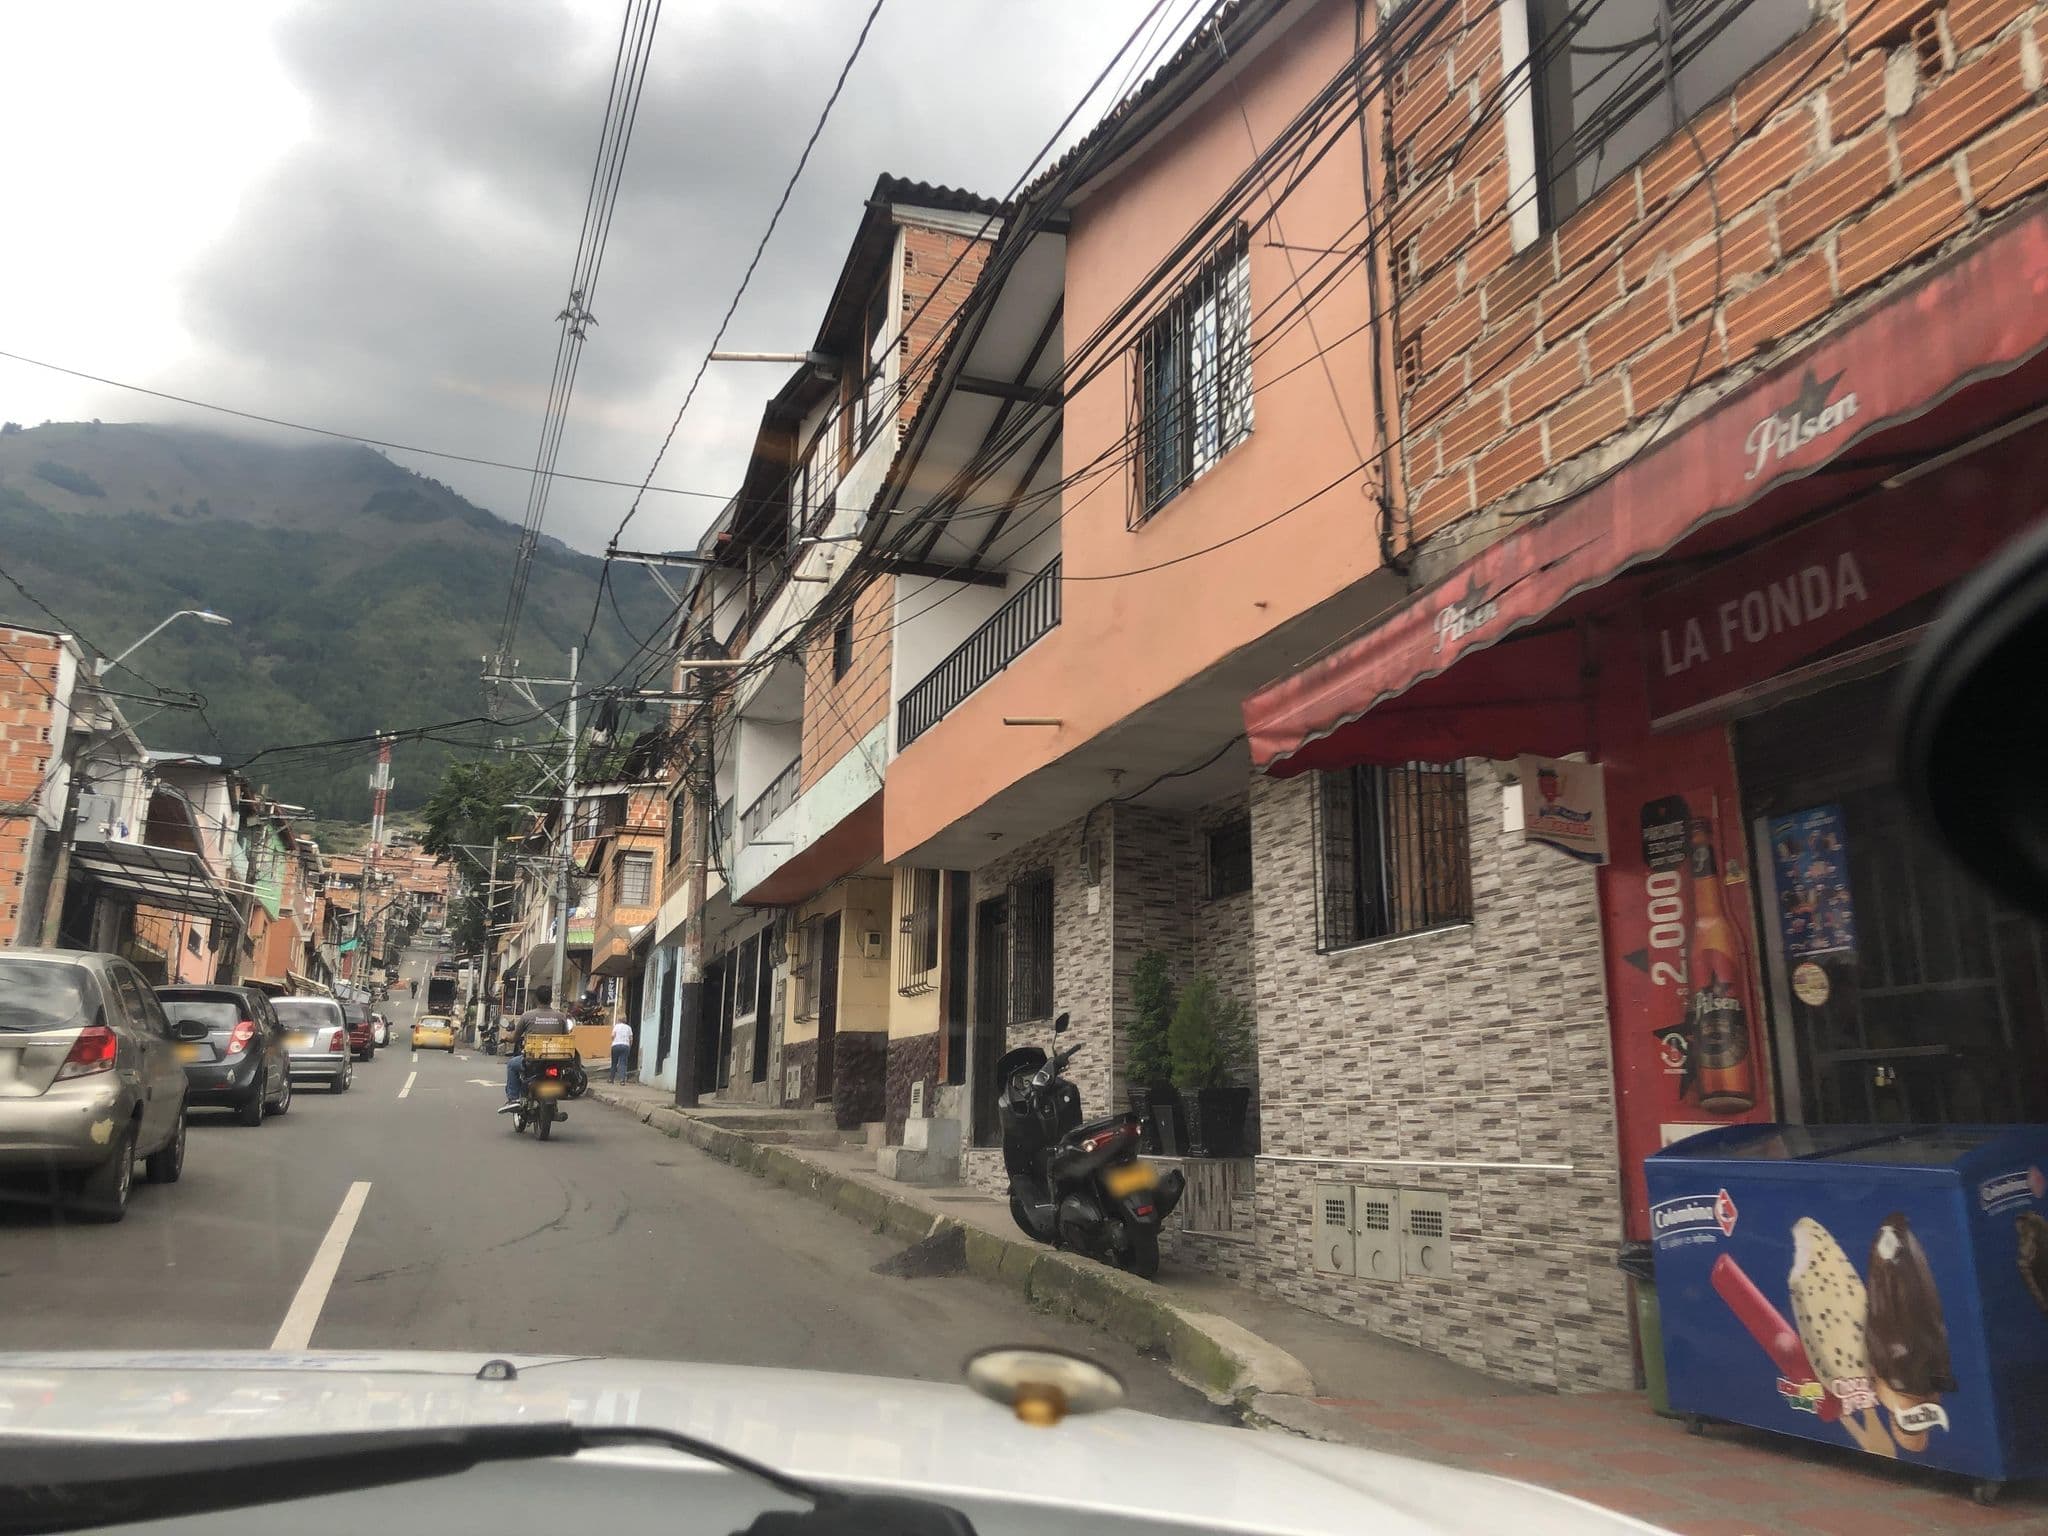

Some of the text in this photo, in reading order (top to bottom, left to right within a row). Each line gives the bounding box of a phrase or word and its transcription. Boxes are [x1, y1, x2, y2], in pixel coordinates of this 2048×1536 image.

[1744, 391, 1860, 480] Pilsen
[1432, 600, 1498, 654] Pilsen
[1660, 552, 1868, 676] LA FONDA
[1655, 1202, 1715, 1229] Colombina
